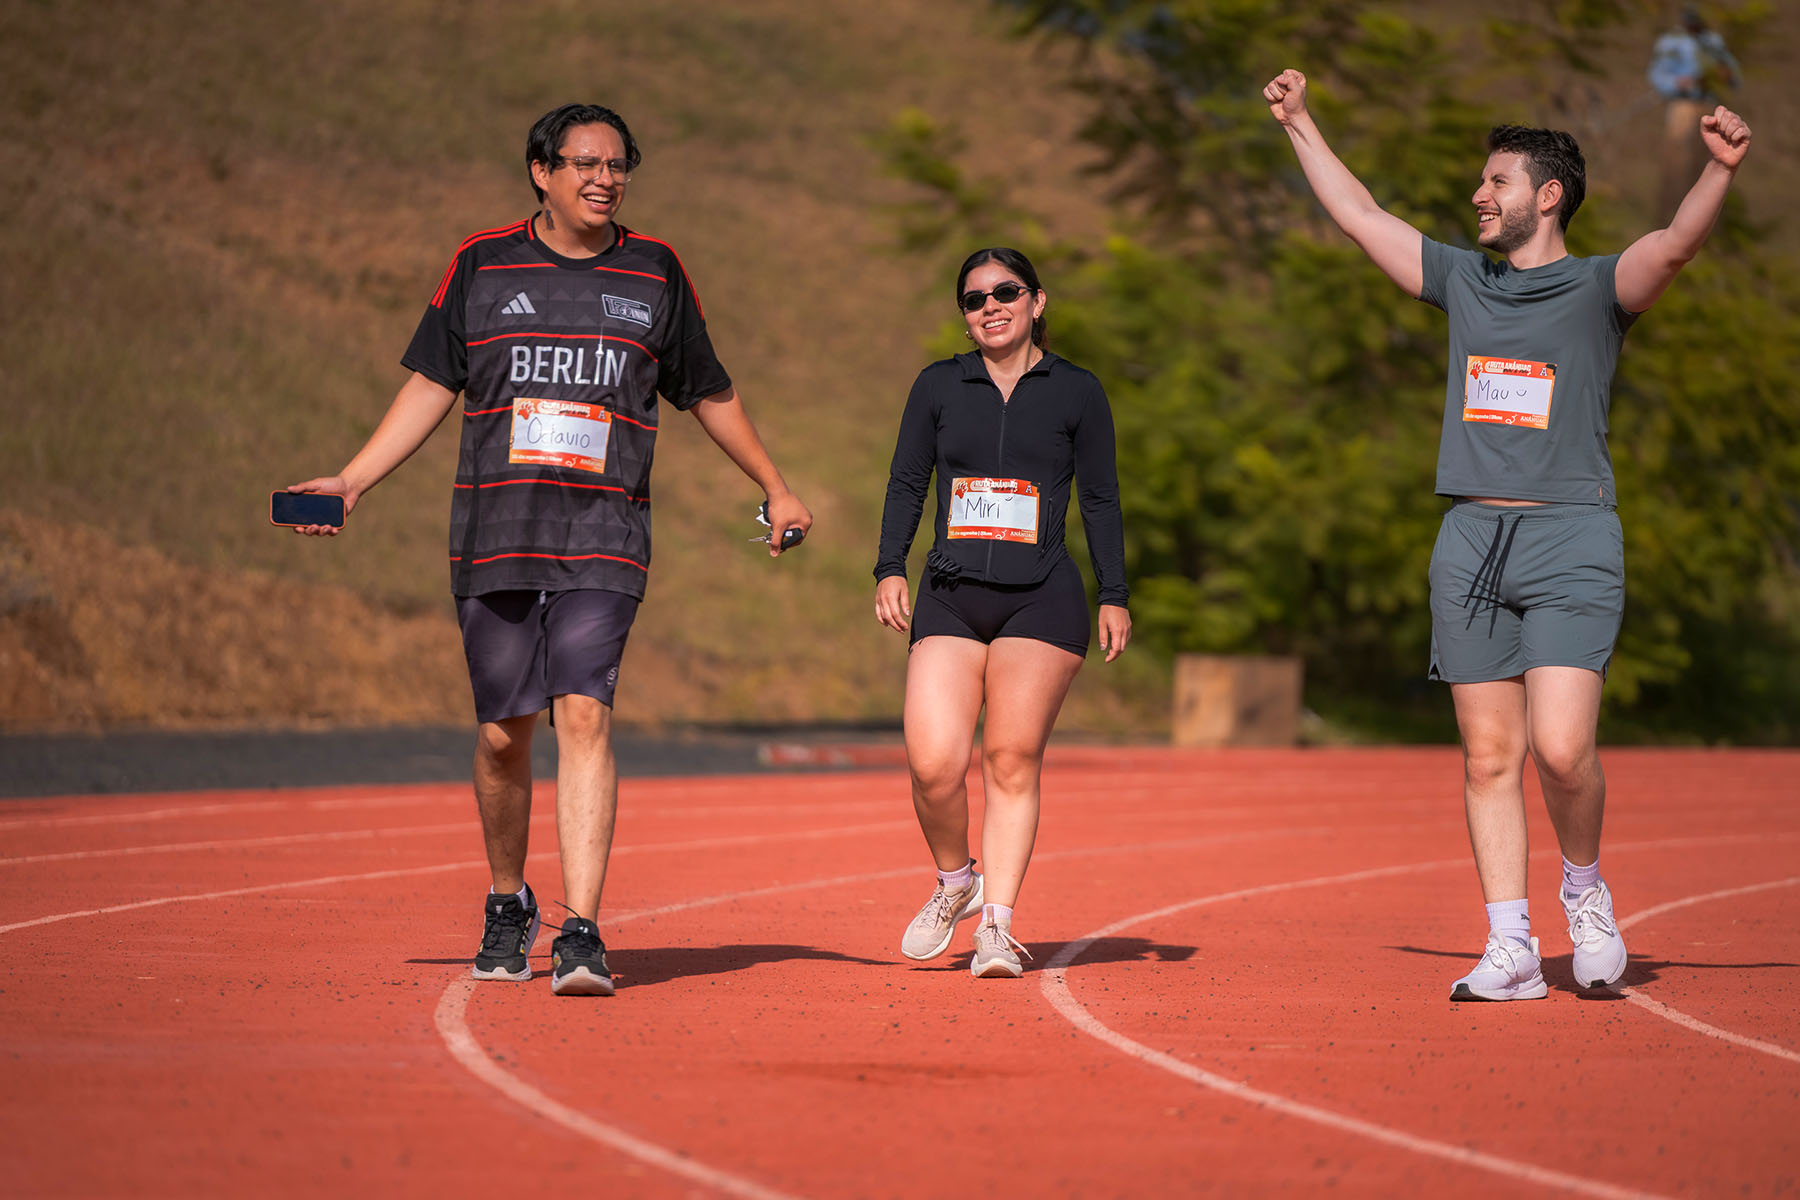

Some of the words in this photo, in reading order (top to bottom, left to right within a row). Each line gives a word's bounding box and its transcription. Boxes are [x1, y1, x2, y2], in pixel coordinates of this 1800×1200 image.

[510, 342, 628, 388] BERLIN
[1477, 379, 1510, 401] Mau
[527, 416, 591, 449] Octavio
[964, 495, 1001, 520] Miri
